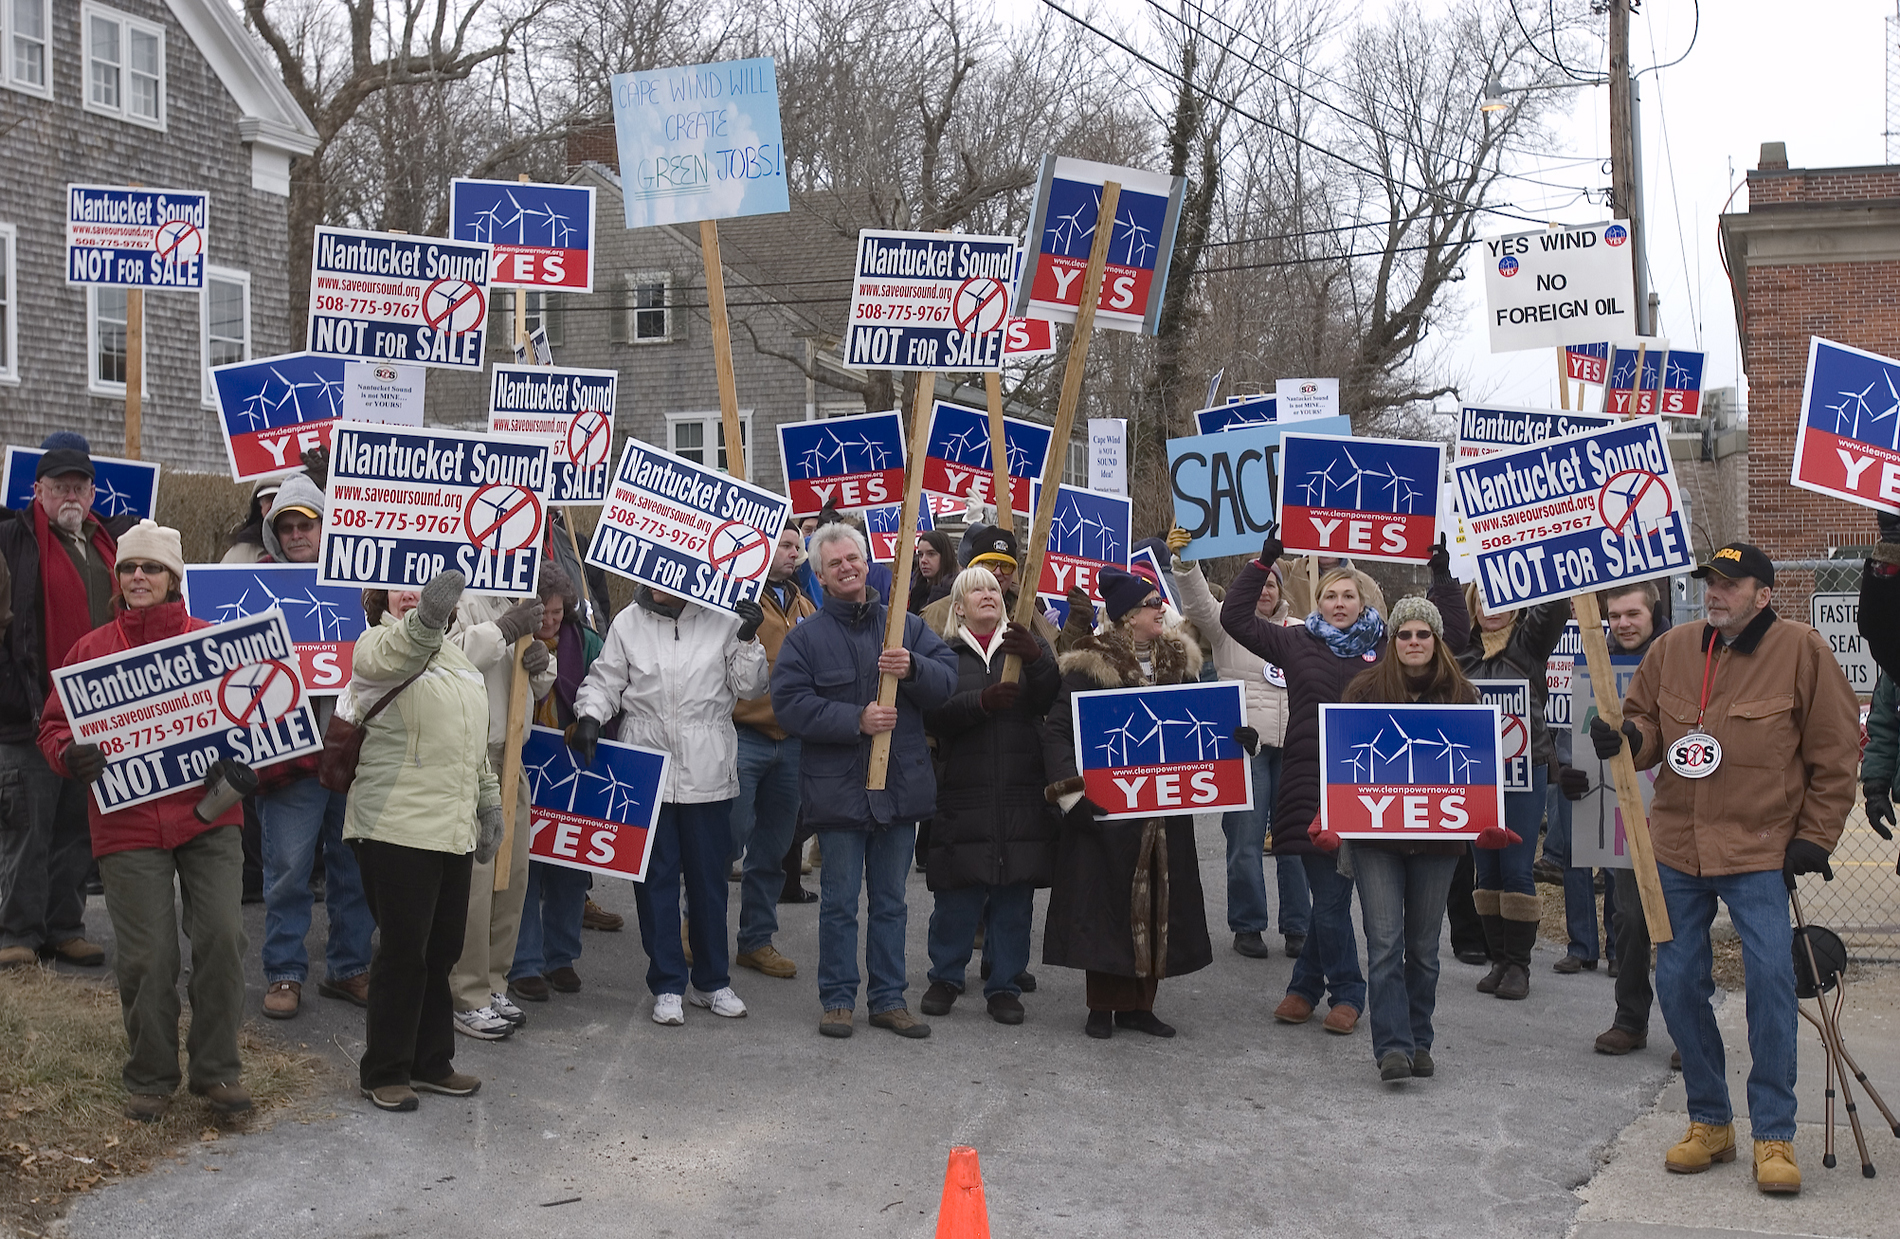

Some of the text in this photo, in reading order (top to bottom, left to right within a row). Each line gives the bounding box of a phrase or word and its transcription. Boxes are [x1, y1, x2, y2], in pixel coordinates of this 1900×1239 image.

[618, 66, 768, 108] CAPE WIND WILL
[665, 109, 728, 141] CREATE
[638, 143, 780, 189] GREEN JOBS!
[73, 190, 203, 228] Nantucket Sound
[72, 225, 154, 239] www.saveoursound.org
[75, 238, 150, 248] 508-775-9767
[1488, 230, 1596, 257] YES WIND
[74, 248, 199, 286] NOT FOR SALE
[321, 235, 487, 283] Nantucket Sound
[494, 245, 564, 257] .cleanpowernow.org
[863, 239, 1012, 280] Nantucket Sound
[1053, 258, 1136, 277] www.clearnow.org
[317, 276, 420, 300] www.saveoursound.org
[859, 284, 952, 303] www.saveoursound.org
[1536, 274, 1567, 291] NO
[316, 295, 420, 318] 508-775-9767
[856, 304, 950, 322] 508-775-9767
[1496, 297, 1624, 326] FOREIGN OIL
[316, 317, 369, 354] NOT
[375, 331, 408, 358] FOR
[415, 327, 478, 365] SALE
[854, 327, 903, 364] NOT
[907, 338, 939, 365] FOR
[945, 330, 999, 366] SALE
[1572, 358, 1600, 381] YES
[497, 373, 612, 412] Nantucket Sound
[1615, 394, 1651, 413] YS
[257, 419, 338, 439] www.cleanpowerno
[493, 417, 567, 436] www.saveoursound.org
[1093, 435, 1120, 445] Cape Wind
[1463, 409, 1552, 443] Nantucket
[258, 430, 333, 466] YE
[339, 433, 464, 482] Nantucket
[470, 443, 546, 488] Sound
[1097, 458, 1117, 466] SOUND
[561, 464, 604, 499] SALE
[810, 471, 883, 485] www.cleanpowernow.org
[945, 468, 1015, 502] YE
[1460, 427, 1664, 515] Nantucket Sound
[1836, 448, 1900, 503] YE
[334, 485, 463, 512] www.saveoursound.org
[623, 449, 722, 512] Nantucket
[721, 486, 783, 535] Sound
[810, 478, 888, 508] YES
[331, 508, 461, 534] 508-775-9767
[608, 506, 707, 552] 508-775-9767
[615, 488, 712, 536] www.saveoursound.org
[1309, 509, 1407, 523] www.cleanpowernow.org
[1472, 494, 1595, 534] www.saveoursound.org
[1309, 517, 1408, 553] YES
[1481, 516, 1592, 550] 508-775-9767
[331, 536, 531, 590] NOT FOR SALE
[596, 528, 756, 610] NOT FOR SALE
[1485, 516, 1683, 604] NOT FOR SALE
[1820, 605, 1859, 623] FASTE
[1829, 635, 1861, 653] SEAT
[66, 646, 203, 714] Nantucket
[202, 620, 285, 675] Sound
[1840, 665, 1867, 683] LTS
[79, 689, 212, 737] www.saveoursound.org
[1482, 687, 1524, 714] ound
[99, 709, 218, 758] 08-775-9767
[102, 709, 311, 805] NOT FOR SALE
[1112, 762, 1214, 777] www.cleanpowernow.org
[1112, 771, 1220, 809] YES
[1358, 785, 1466, 795] www.cleanpowernow.org
[531, 809, 618, 832] w.cleanpowernow.org
[1357, 795, 1469, 829] YES
